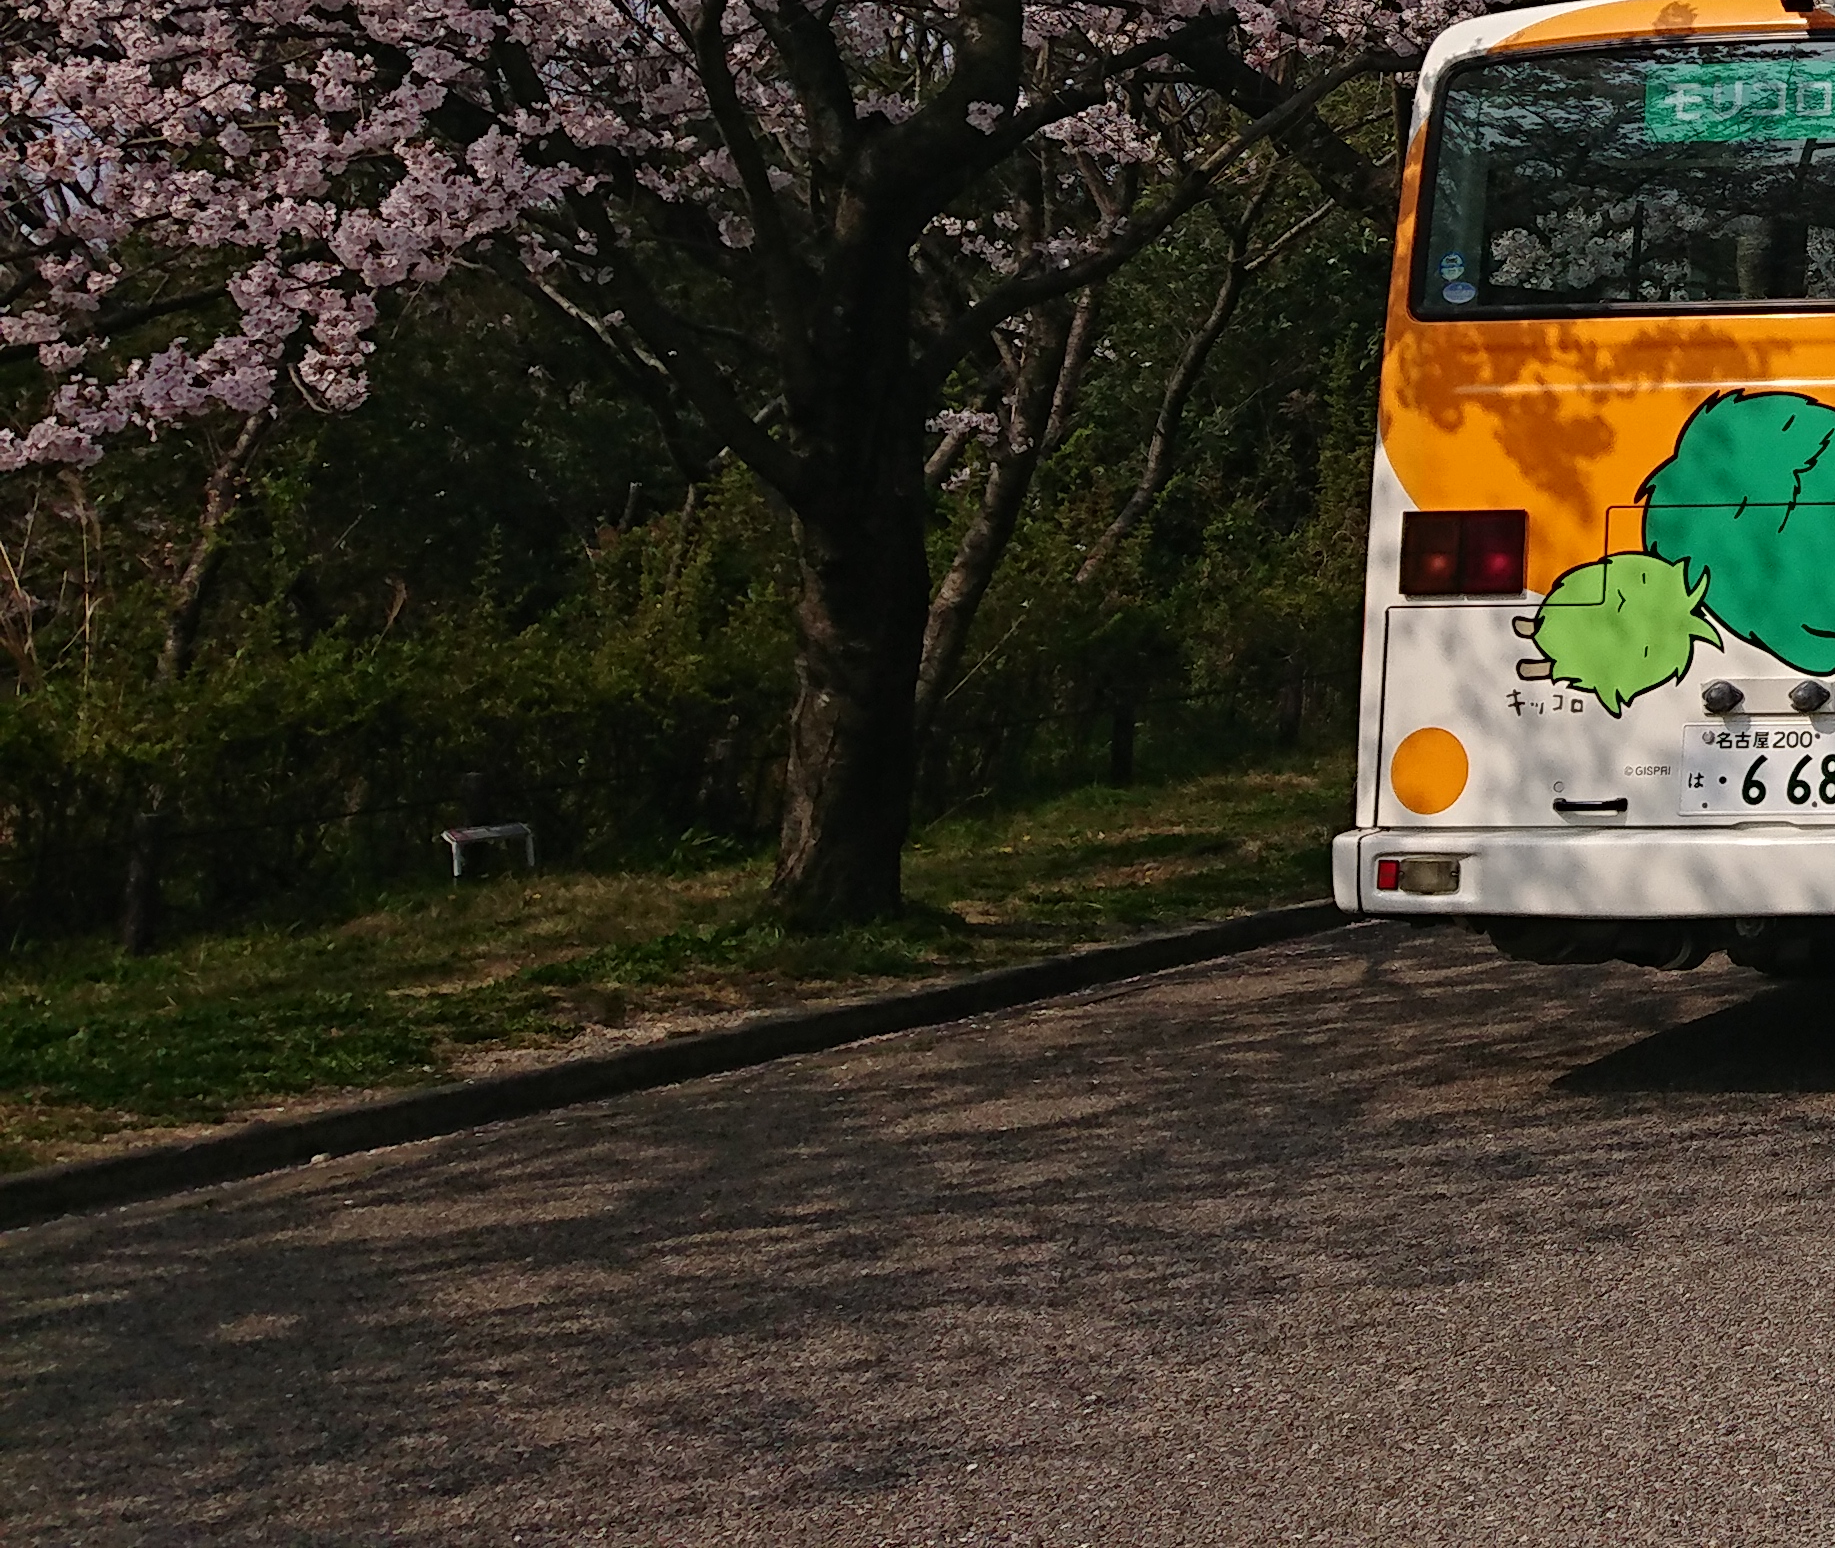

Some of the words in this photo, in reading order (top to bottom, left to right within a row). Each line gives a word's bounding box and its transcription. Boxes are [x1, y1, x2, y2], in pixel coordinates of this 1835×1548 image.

[1506, 688, 1584, 717] キッコロ
[1688, 772, 1705, 789] は
